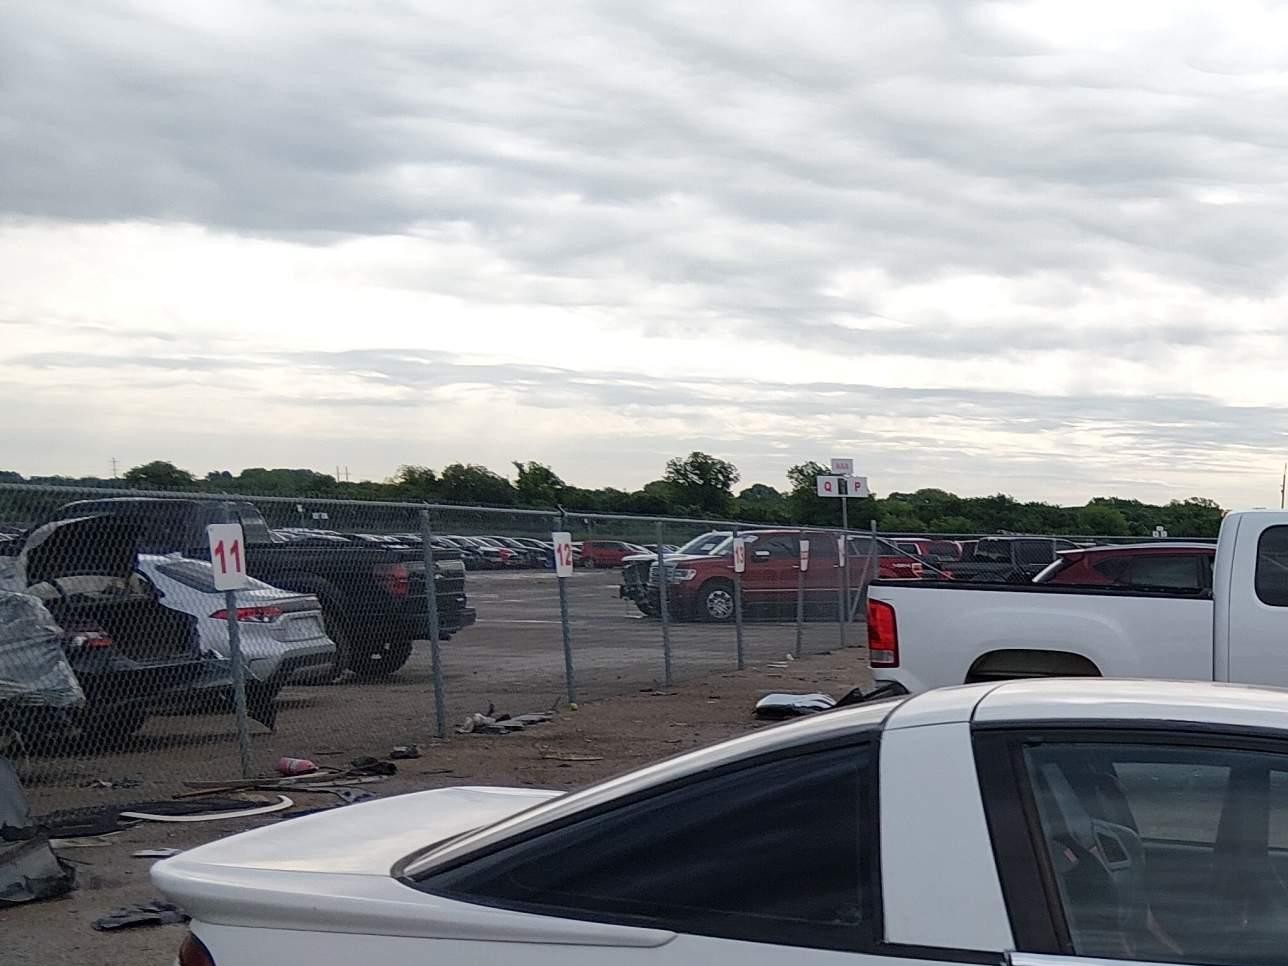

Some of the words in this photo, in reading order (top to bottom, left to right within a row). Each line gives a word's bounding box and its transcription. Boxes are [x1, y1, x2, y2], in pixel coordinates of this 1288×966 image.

[824, 481, 832, 492] Q
[854, 482, 861, 492] P
[215, 540, 241, 574] 11
[557, 543, 572, 566] 12
